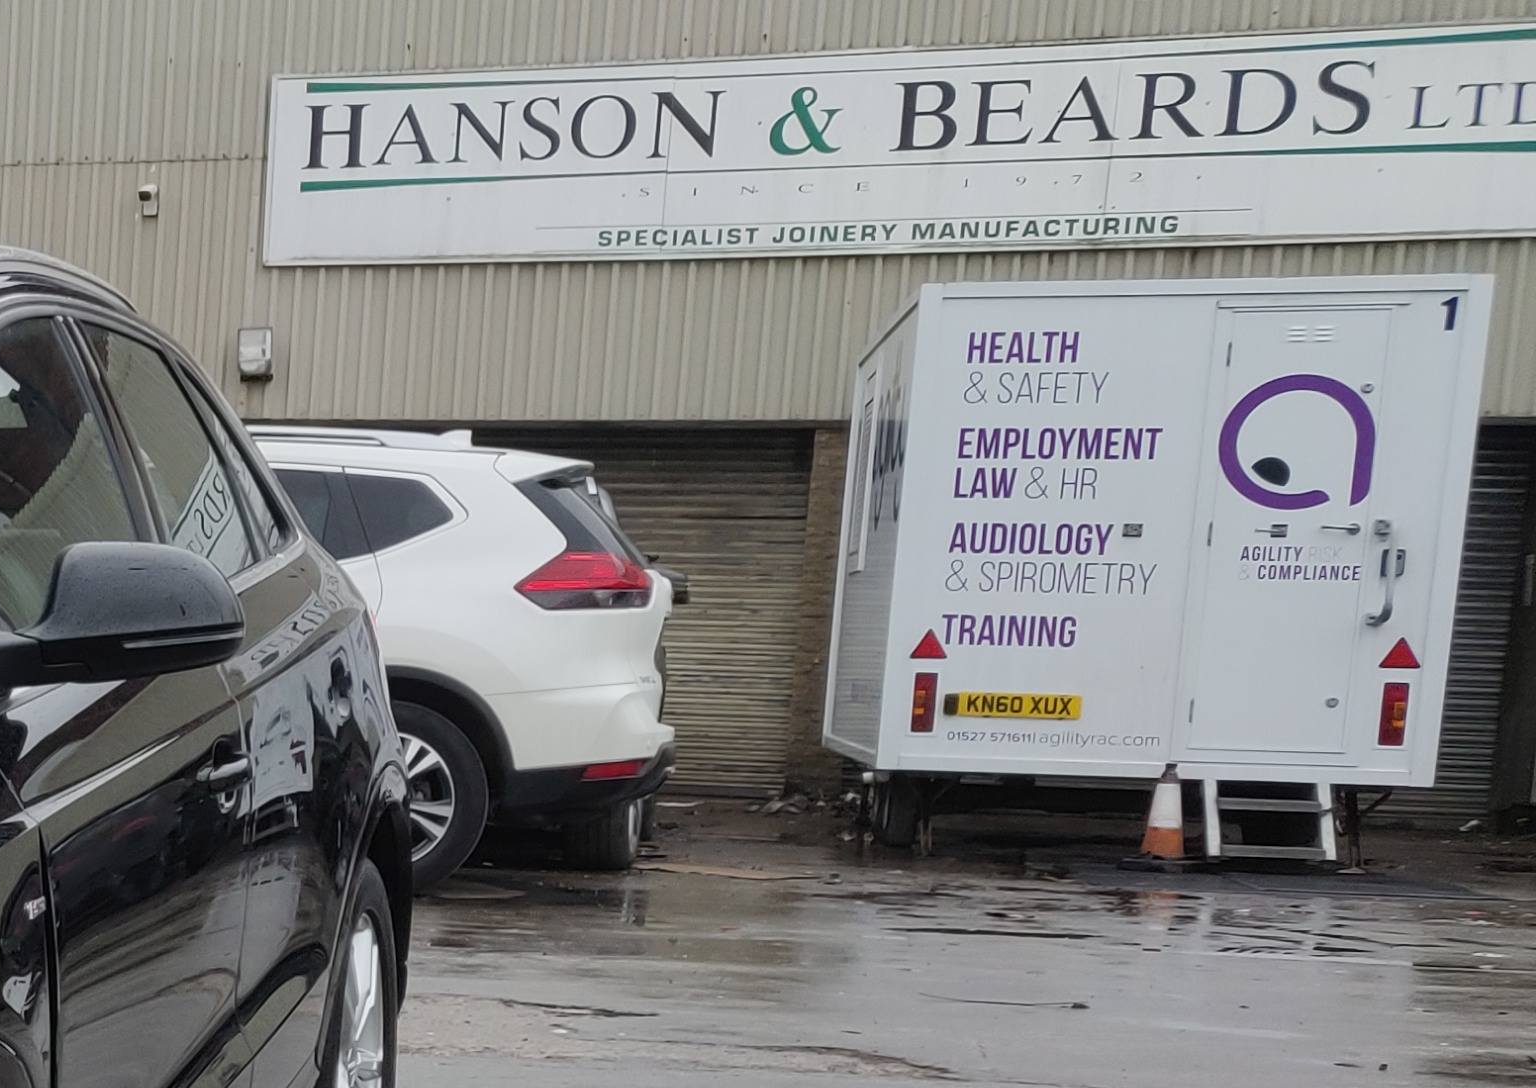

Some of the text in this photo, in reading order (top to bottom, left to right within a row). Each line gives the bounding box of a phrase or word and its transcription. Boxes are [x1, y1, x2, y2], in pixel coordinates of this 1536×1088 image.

[301, 90, 727, 169] HANSON
[769, 86, 844, 156] &
[889, 60, 1376, 152] BEARDS
[598, 215, 1180, 248] SPECIALIST JOINERY MANUFACTURING
[1439, 296, 1459, 331] 1
[966, 331, 1080, 364] HEALTH
[963, 371, 1110, 404] & SAFETY
[957, 427, 1164, 460] EMPLOYMENT
[953, 466, 1098, 500] LAW & HR
[948, 522, 1115, 556] AUDIOLOGY
[1239, 545, 1343, 562] AGILITY RISK
[944, 559, 1158, 595] & SPIROMETRY
[1238, 564, 1362, 581] & COMPLIANCE
[942, 614, 1078, 648] TRAINING
[966, 695, 1073, 716] KN60 XUX
[946, 731, 987, 742] 01527
